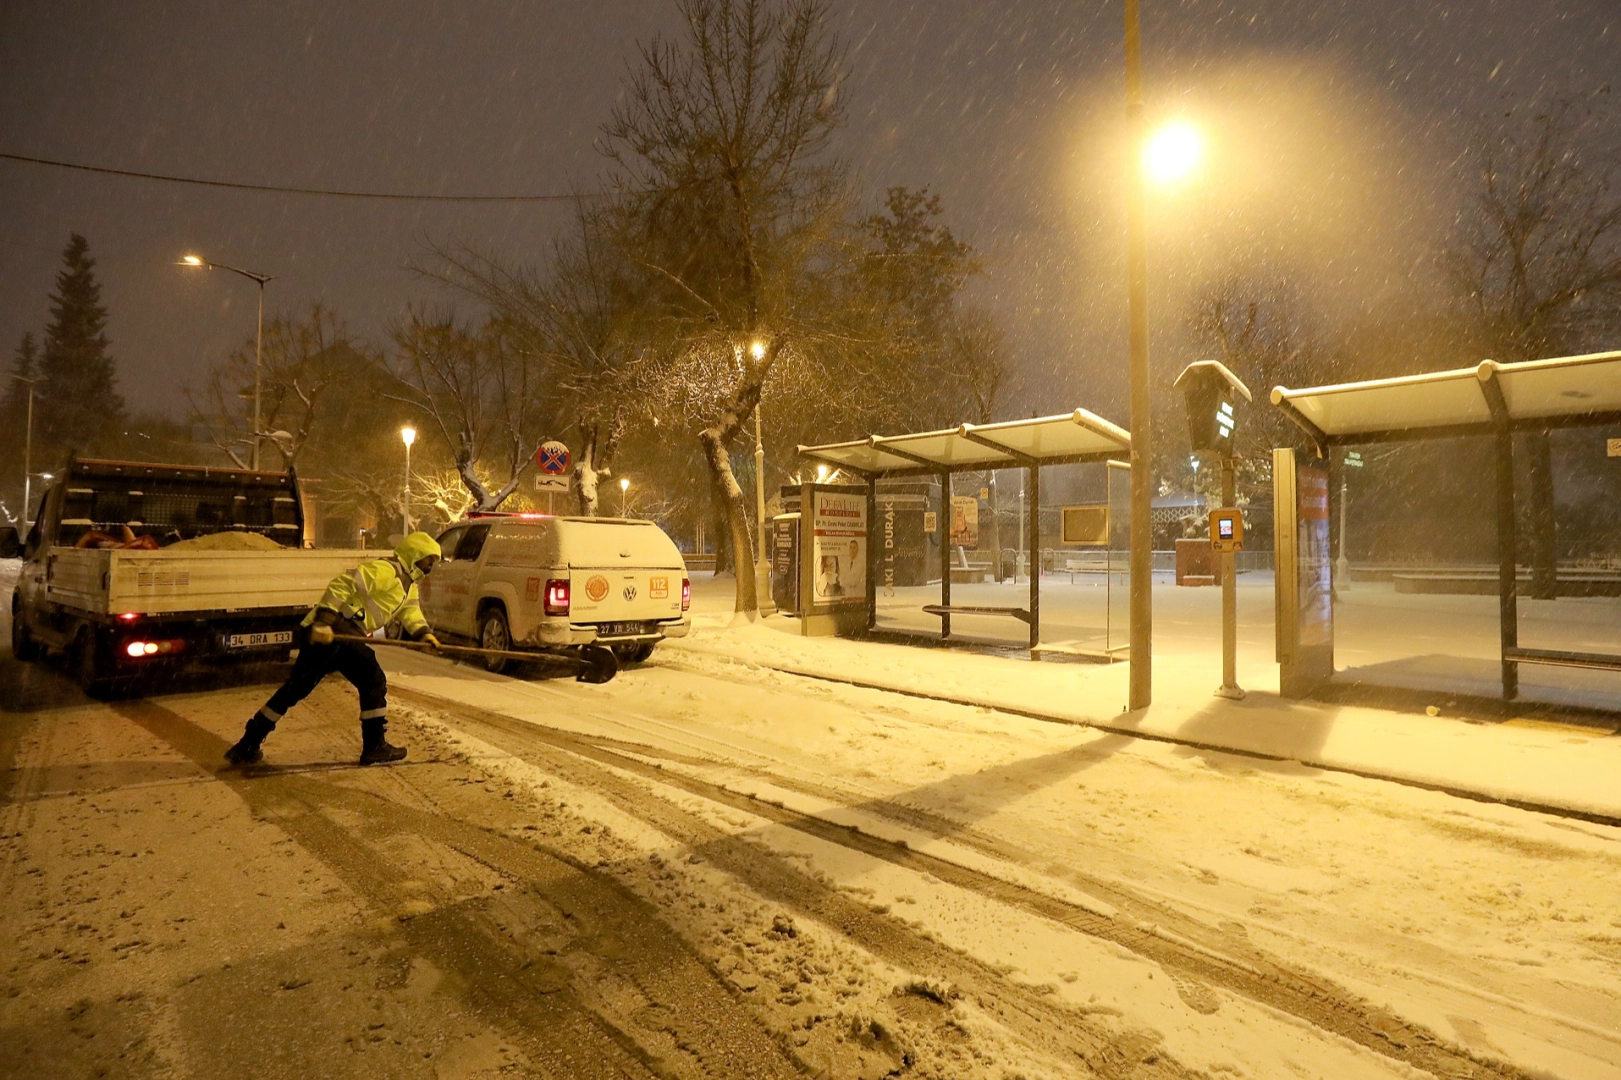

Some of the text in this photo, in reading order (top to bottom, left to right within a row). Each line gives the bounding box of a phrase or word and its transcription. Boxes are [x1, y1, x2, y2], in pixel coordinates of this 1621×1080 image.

[652, 578, 666, 590] 112
[231, 632, 290, 646] 34 DRA 133
